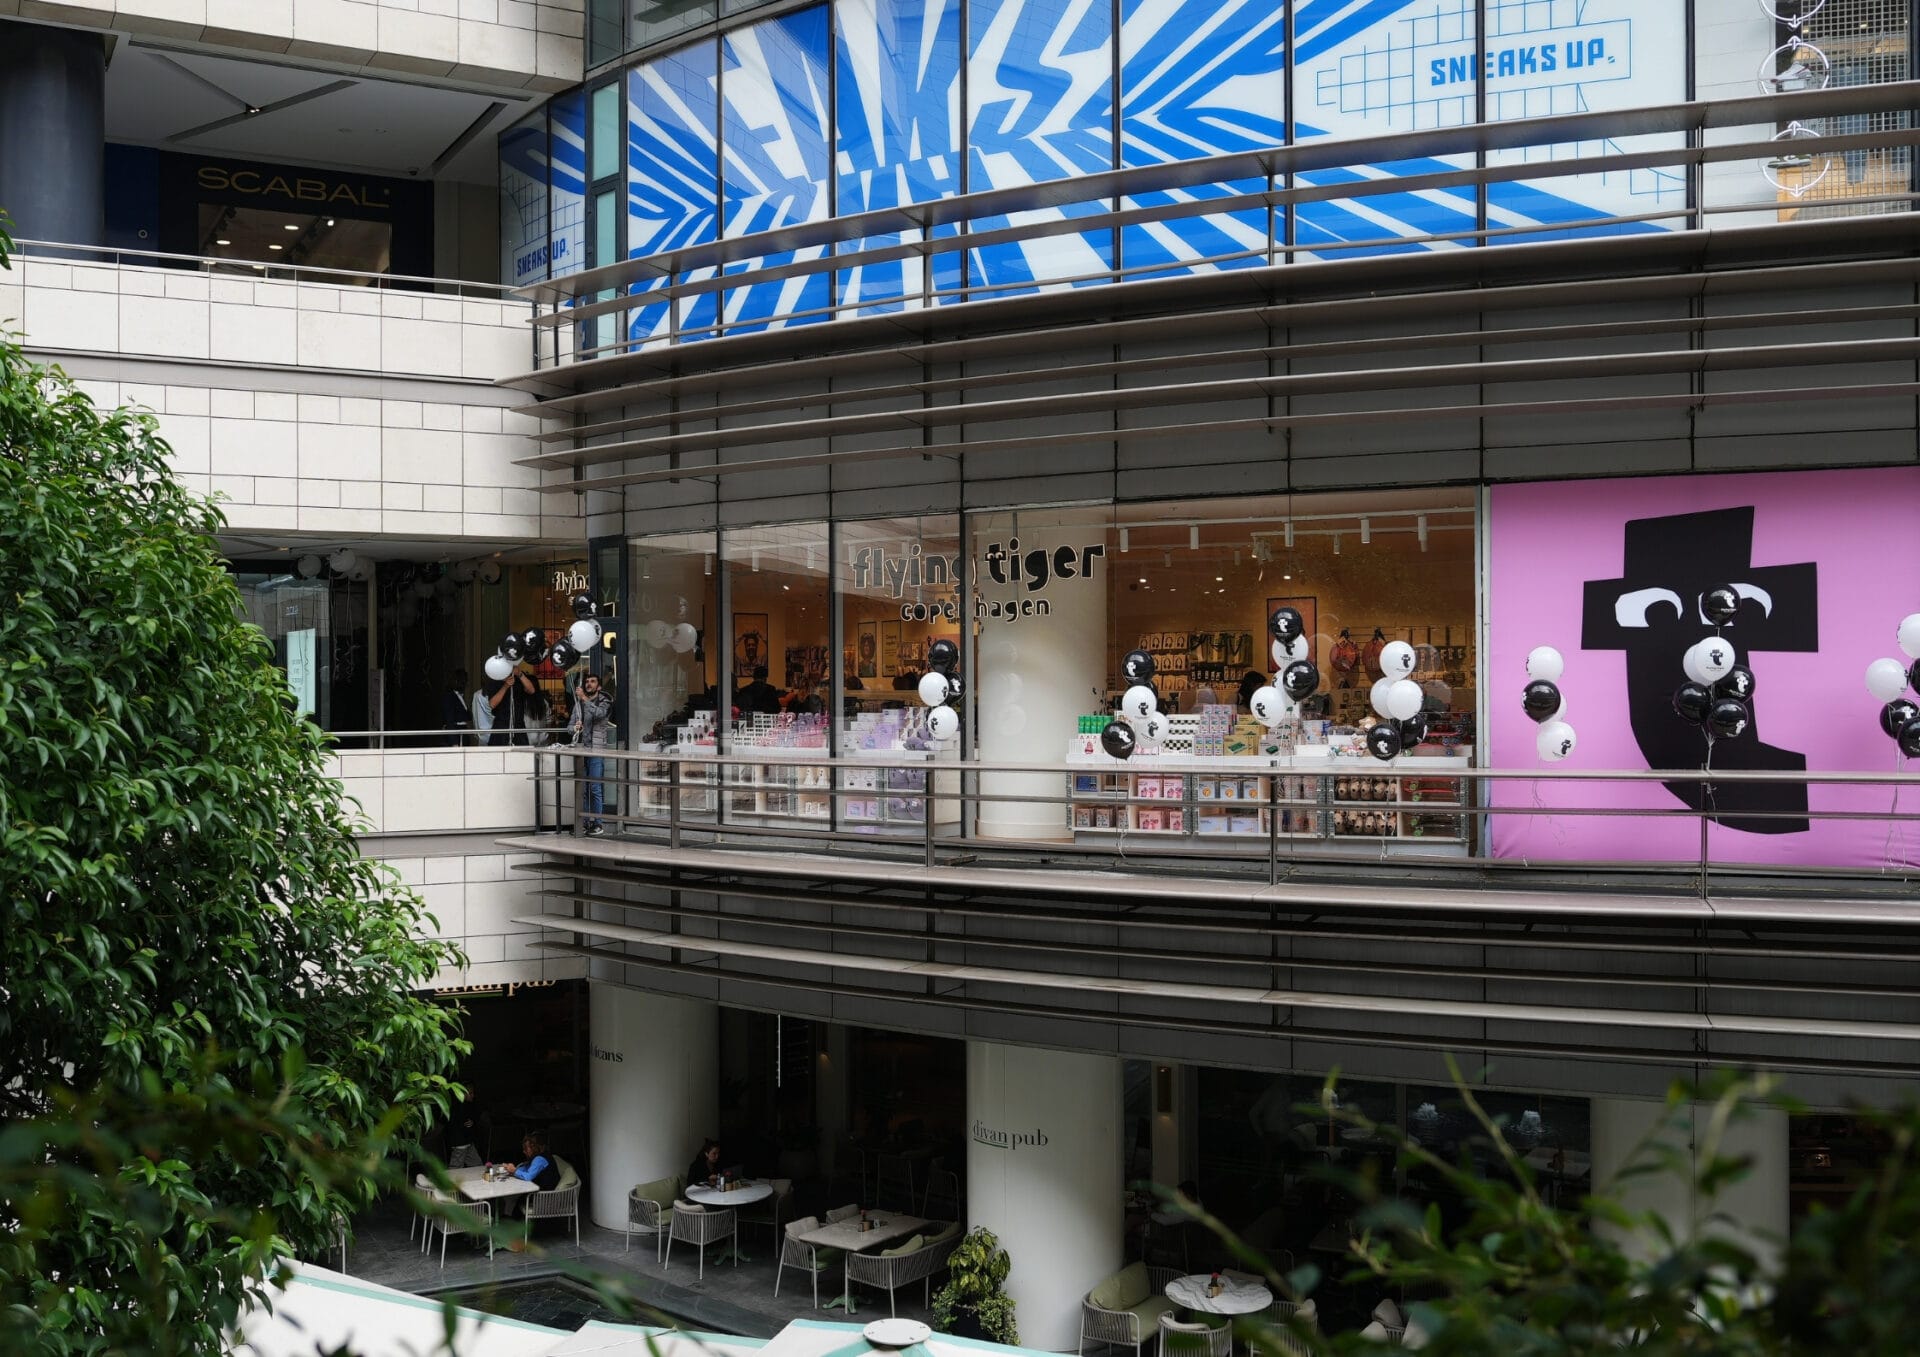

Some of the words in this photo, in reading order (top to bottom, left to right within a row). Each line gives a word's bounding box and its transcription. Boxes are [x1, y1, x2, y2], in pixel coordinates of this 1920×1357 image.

[1431, 44, 1557, 86] SNEAKS
[198, 167, 390, 209] SCABAL
[984, 536, 1106, 593] tiger
[973, 1119, 1008, 1145] divan
[1011, 1128, 1049, 1151] pub
